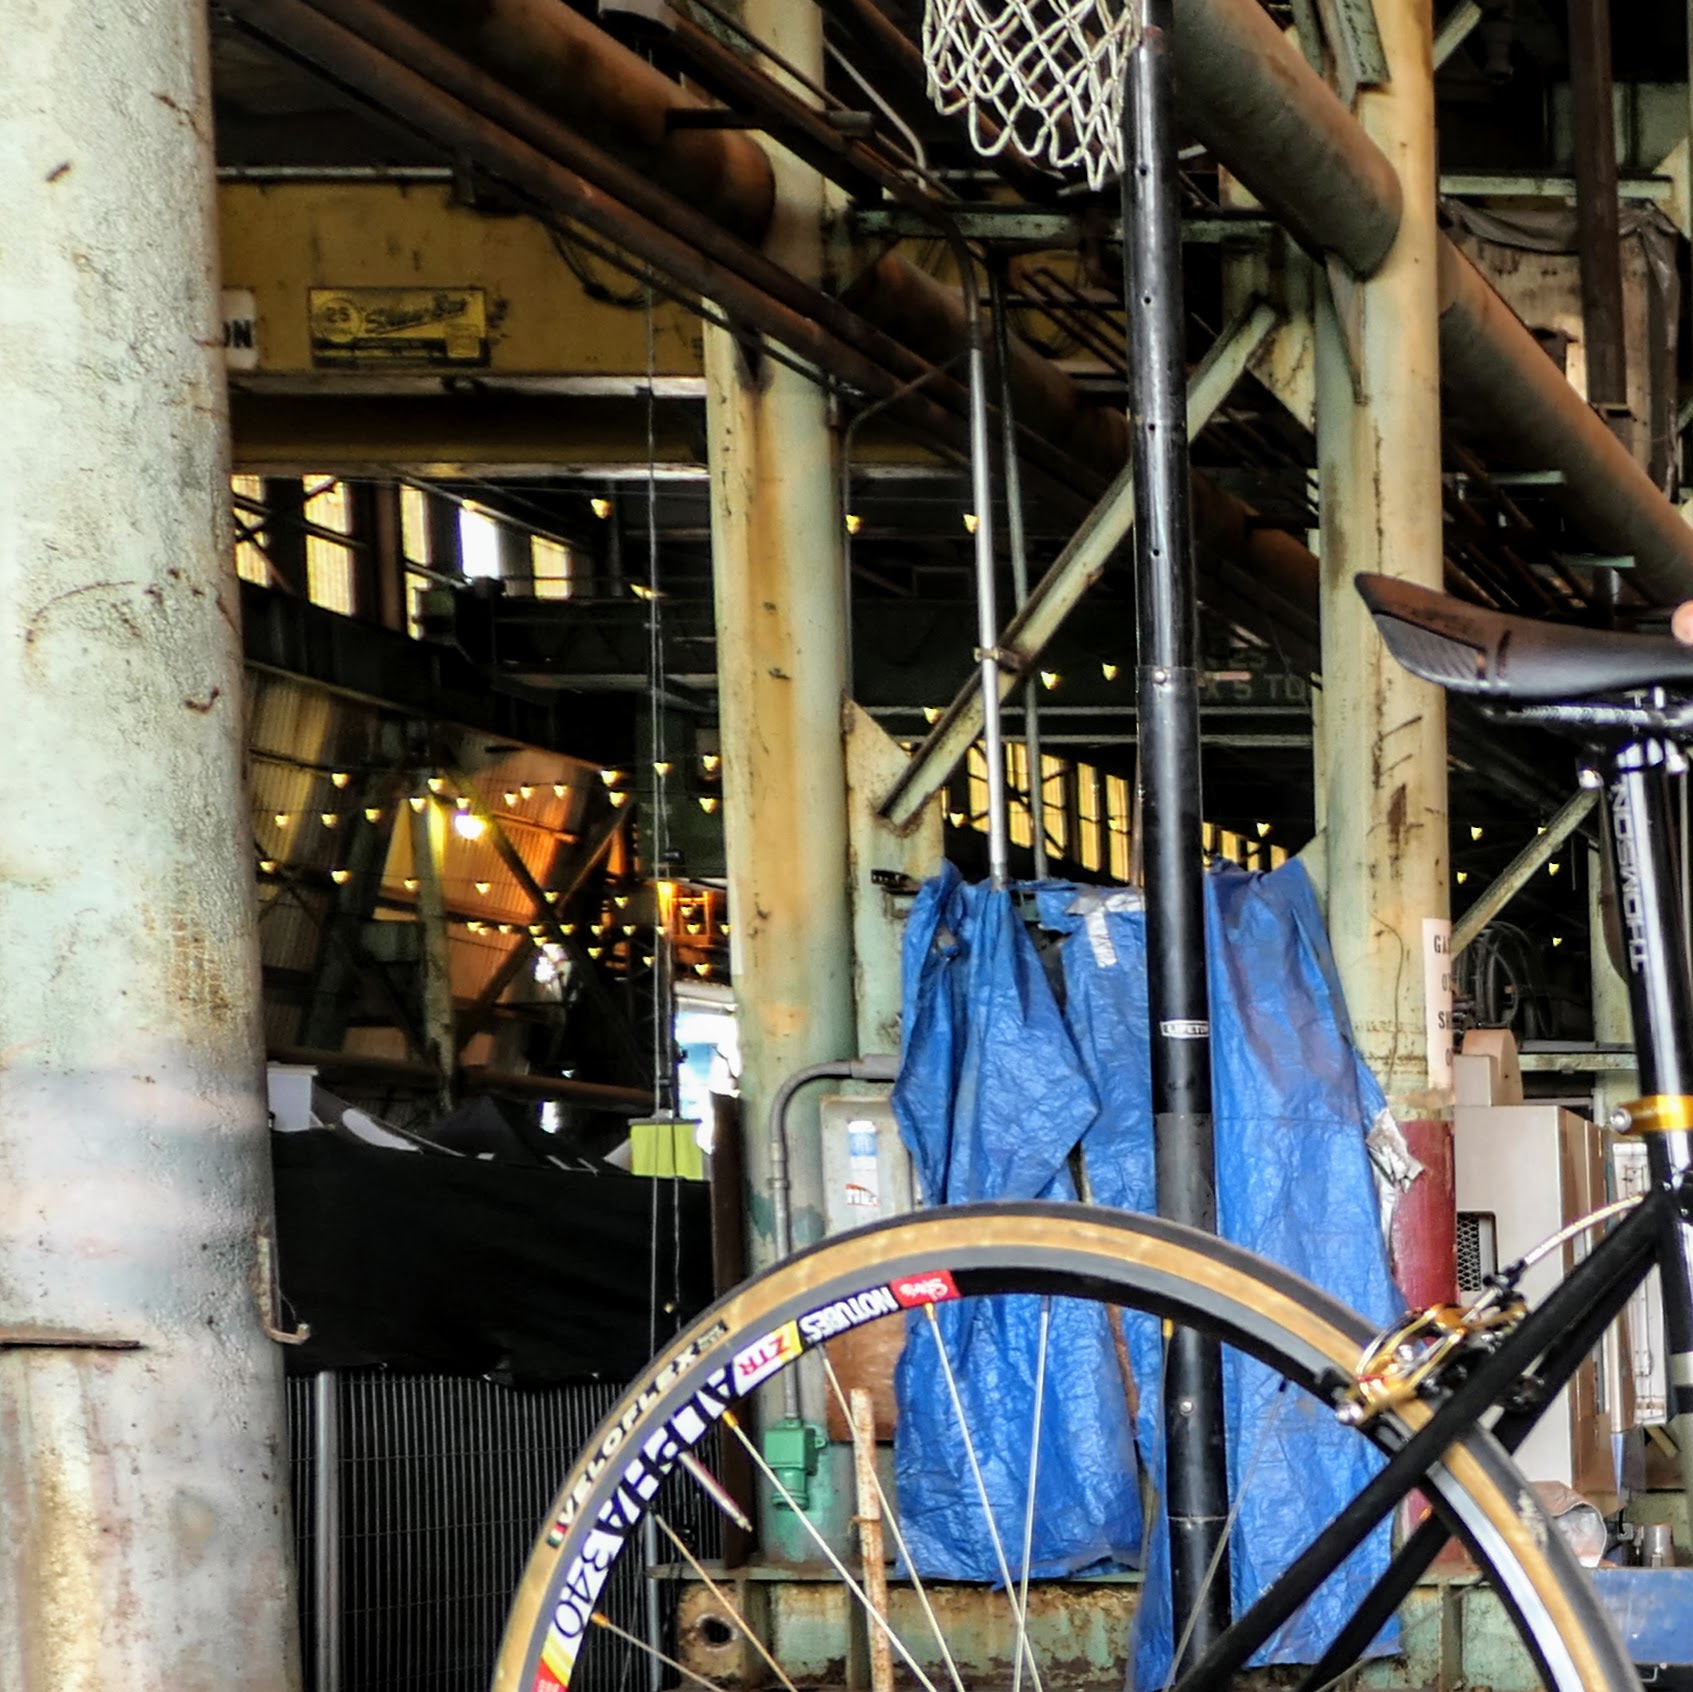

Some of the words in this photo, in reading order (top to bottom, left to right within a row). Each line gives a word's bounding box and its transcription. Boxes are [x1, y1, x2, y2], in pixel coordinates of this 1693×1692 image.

[1609, 782, 1648, 975] THOMSON
[736, 1335, 795, 1378] ZTR
[799, 1286, 900, 1342] NOTUBES
[556, 1344, 702, 1528] VELOFLEX
